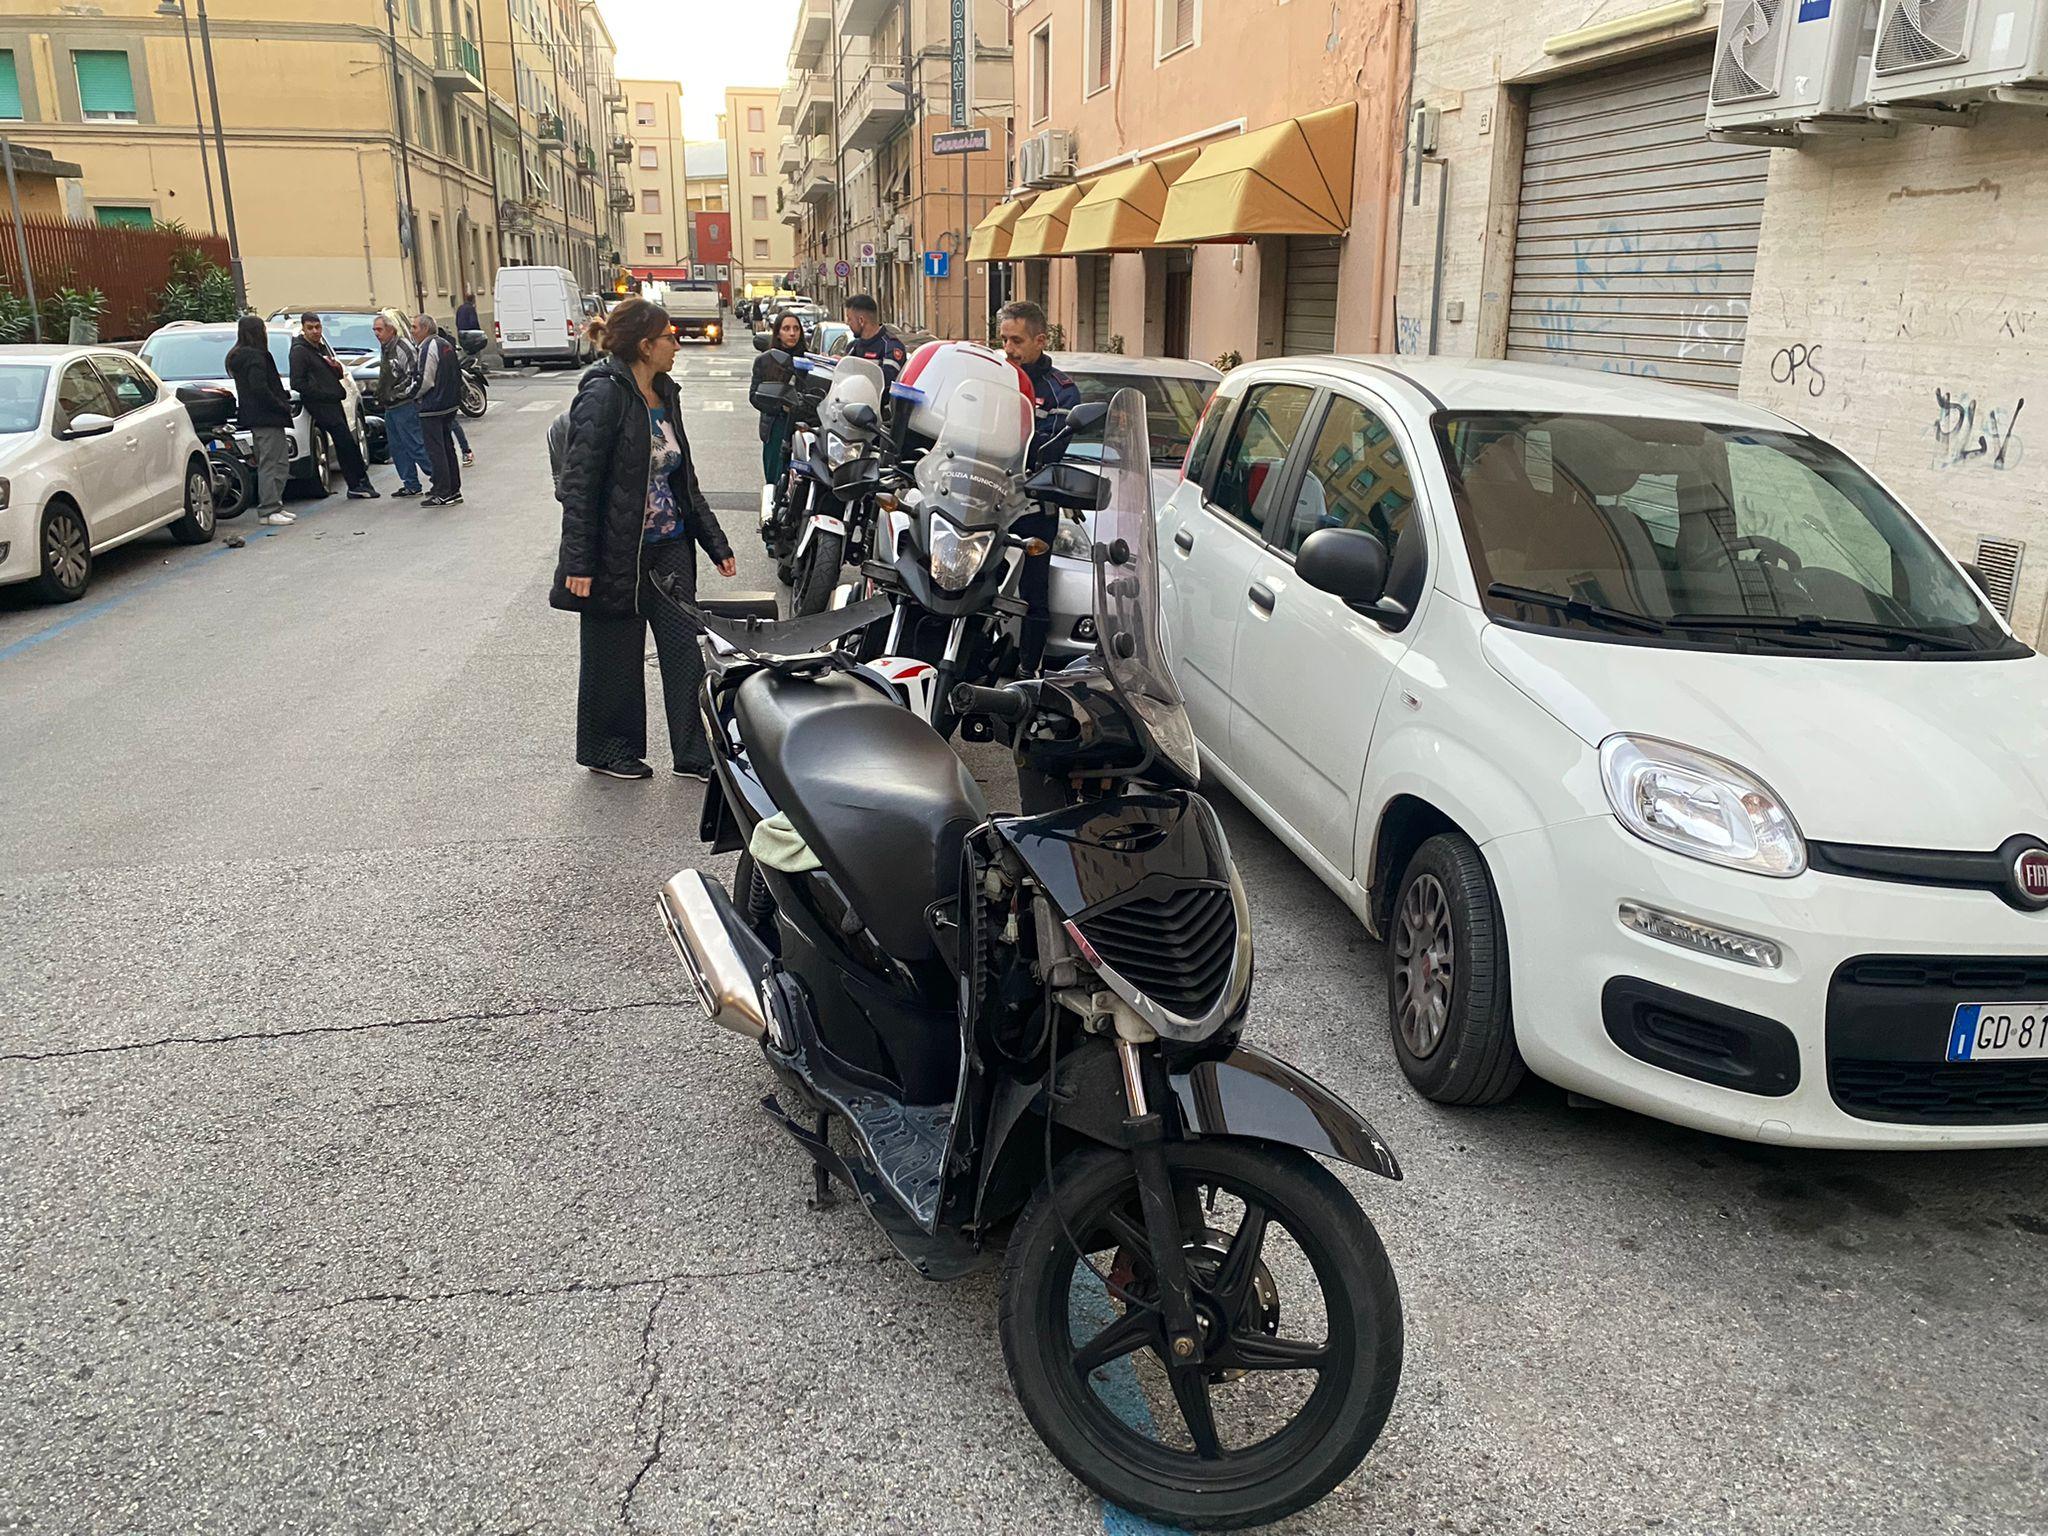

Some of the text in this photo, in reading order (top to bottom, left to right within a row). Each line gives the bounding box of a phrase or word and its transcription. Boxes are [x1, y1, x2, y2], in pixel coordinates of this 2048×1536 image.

[1770, 342, 1826, 397] OPS
[942, 471, 1008, 496] POLIZIA MUNICIPALE
[1977, 1015, 2012, 1050] GD
